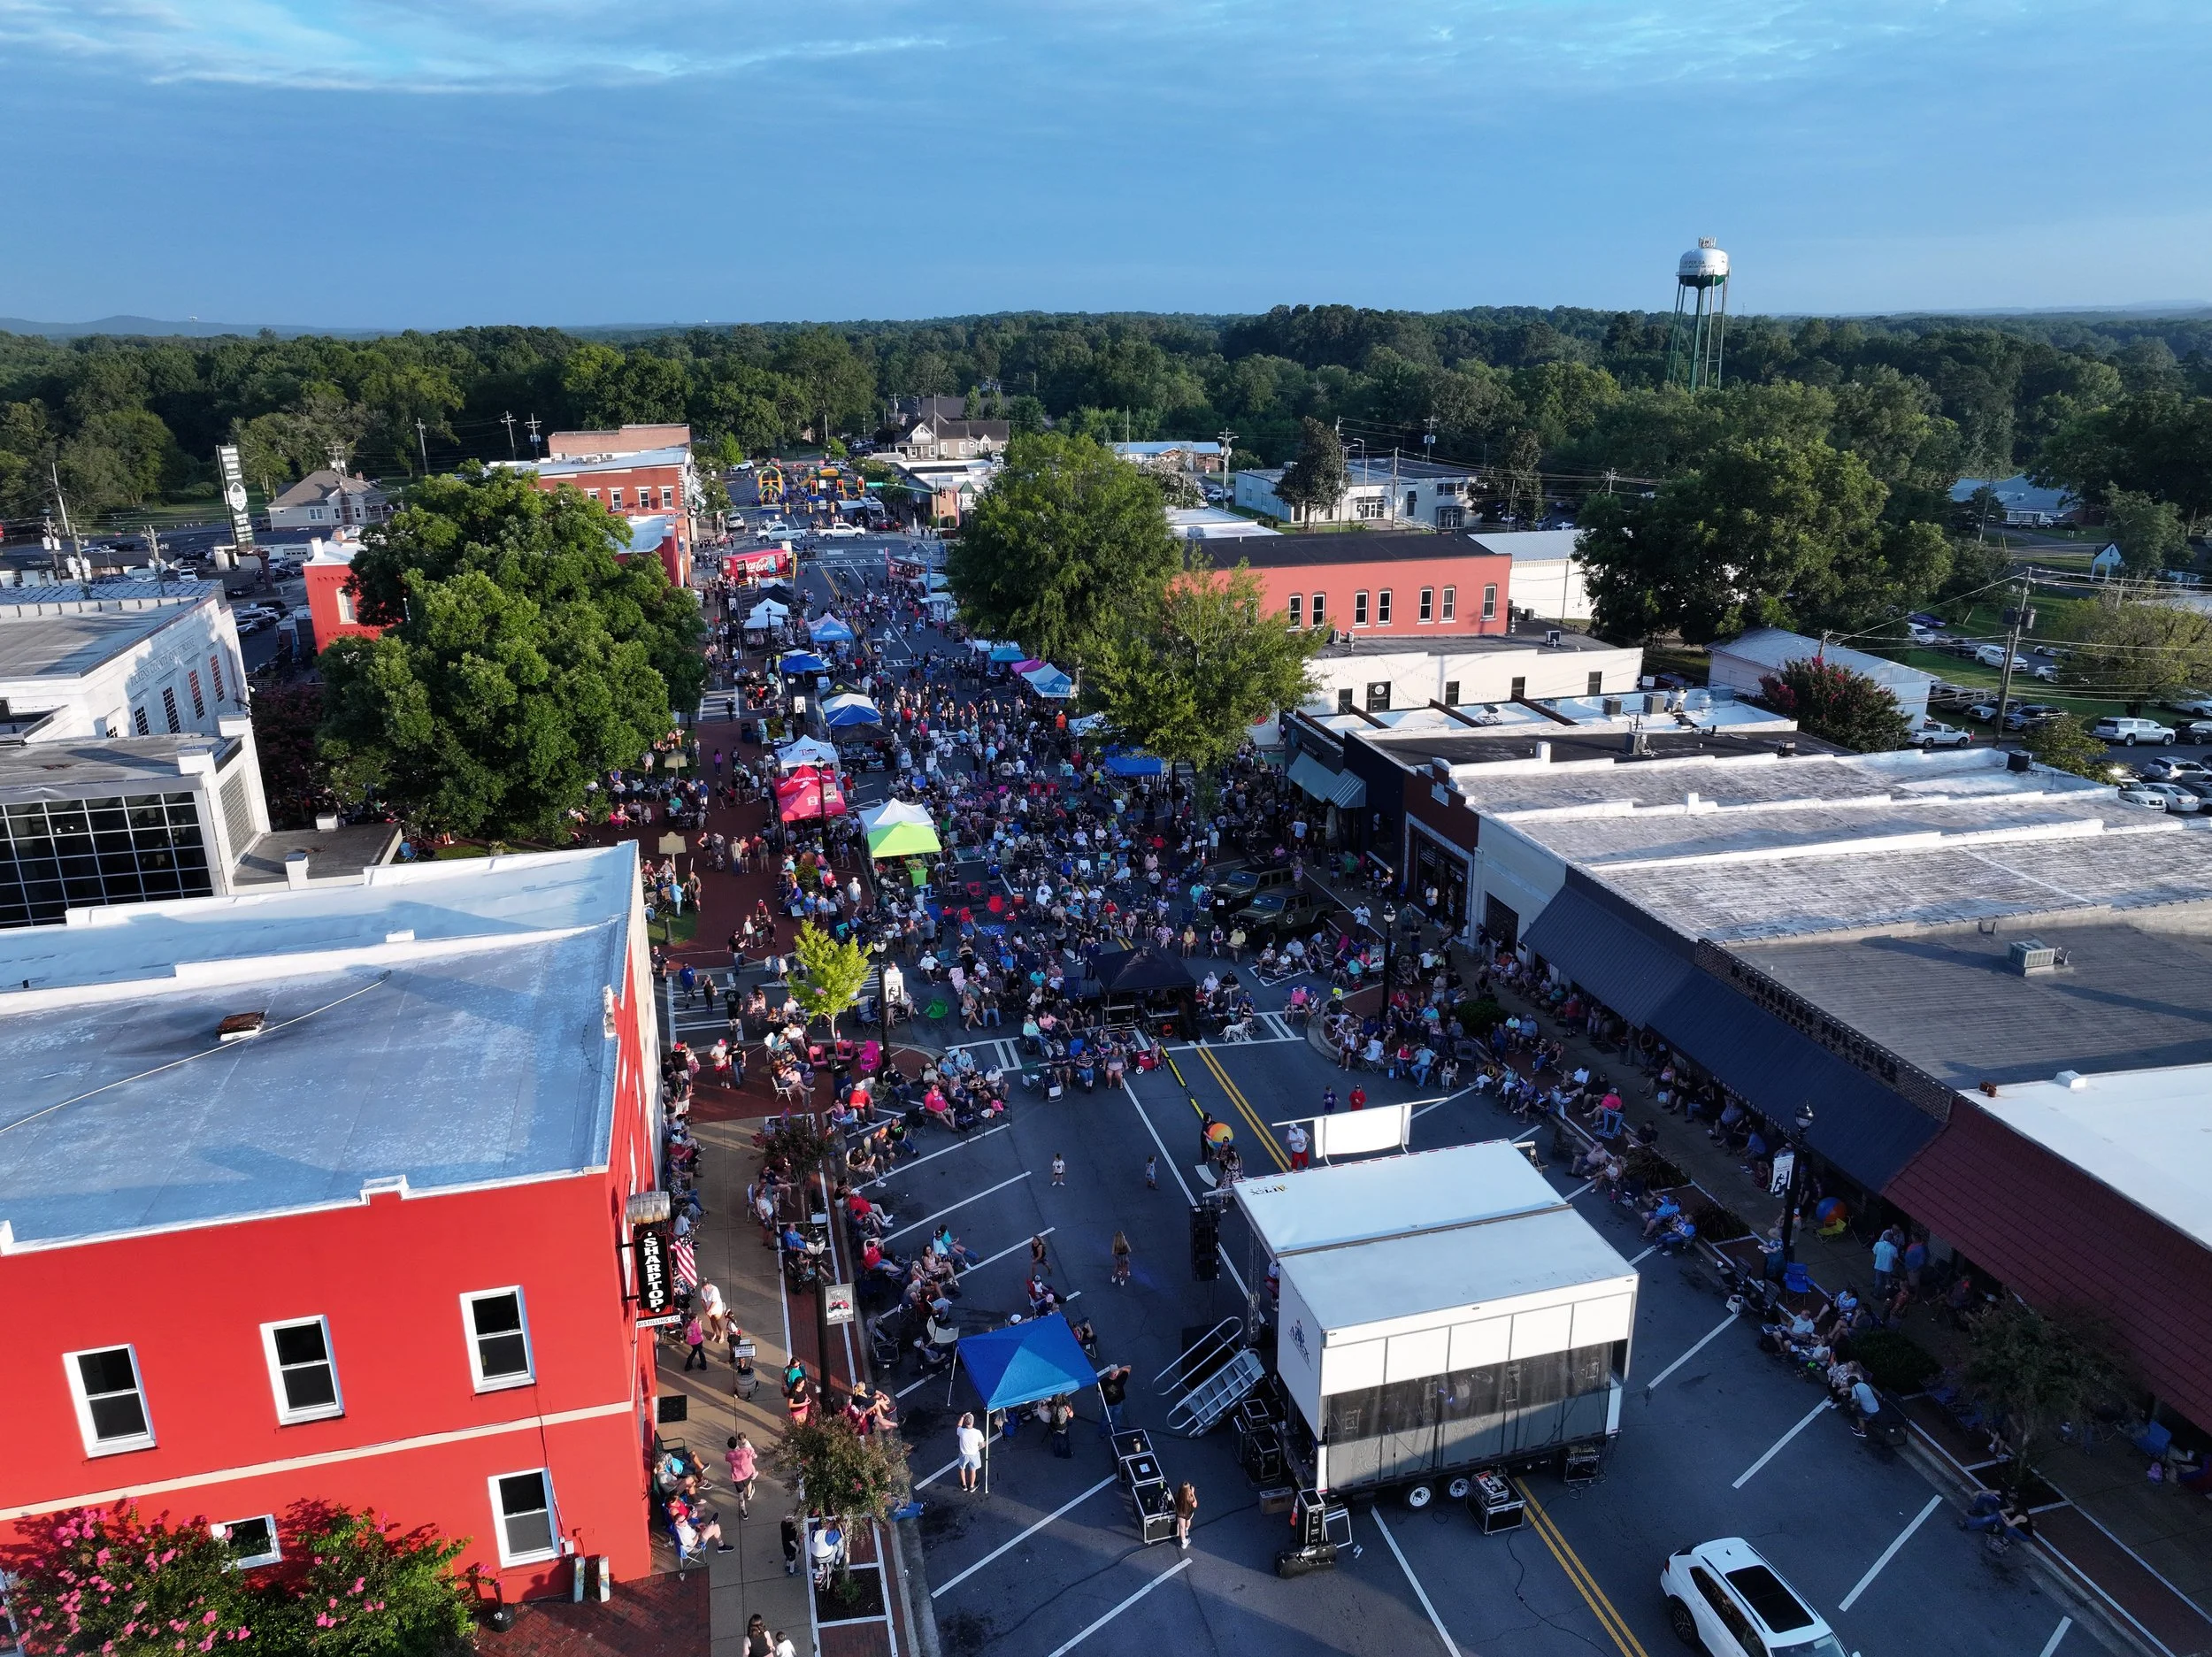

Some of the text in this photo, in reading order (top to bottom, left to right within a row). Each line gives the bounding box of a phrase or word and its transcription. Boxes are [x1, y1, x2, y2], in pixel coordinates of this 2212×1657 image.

[1746, 1100, 1763, 1116] MAIN
[1765, 1114, 1791, 1136] STREET
[643, 1237, 664, 1308] SHARPTOP
[637, 1318, 669, 1327] DISTILLING
